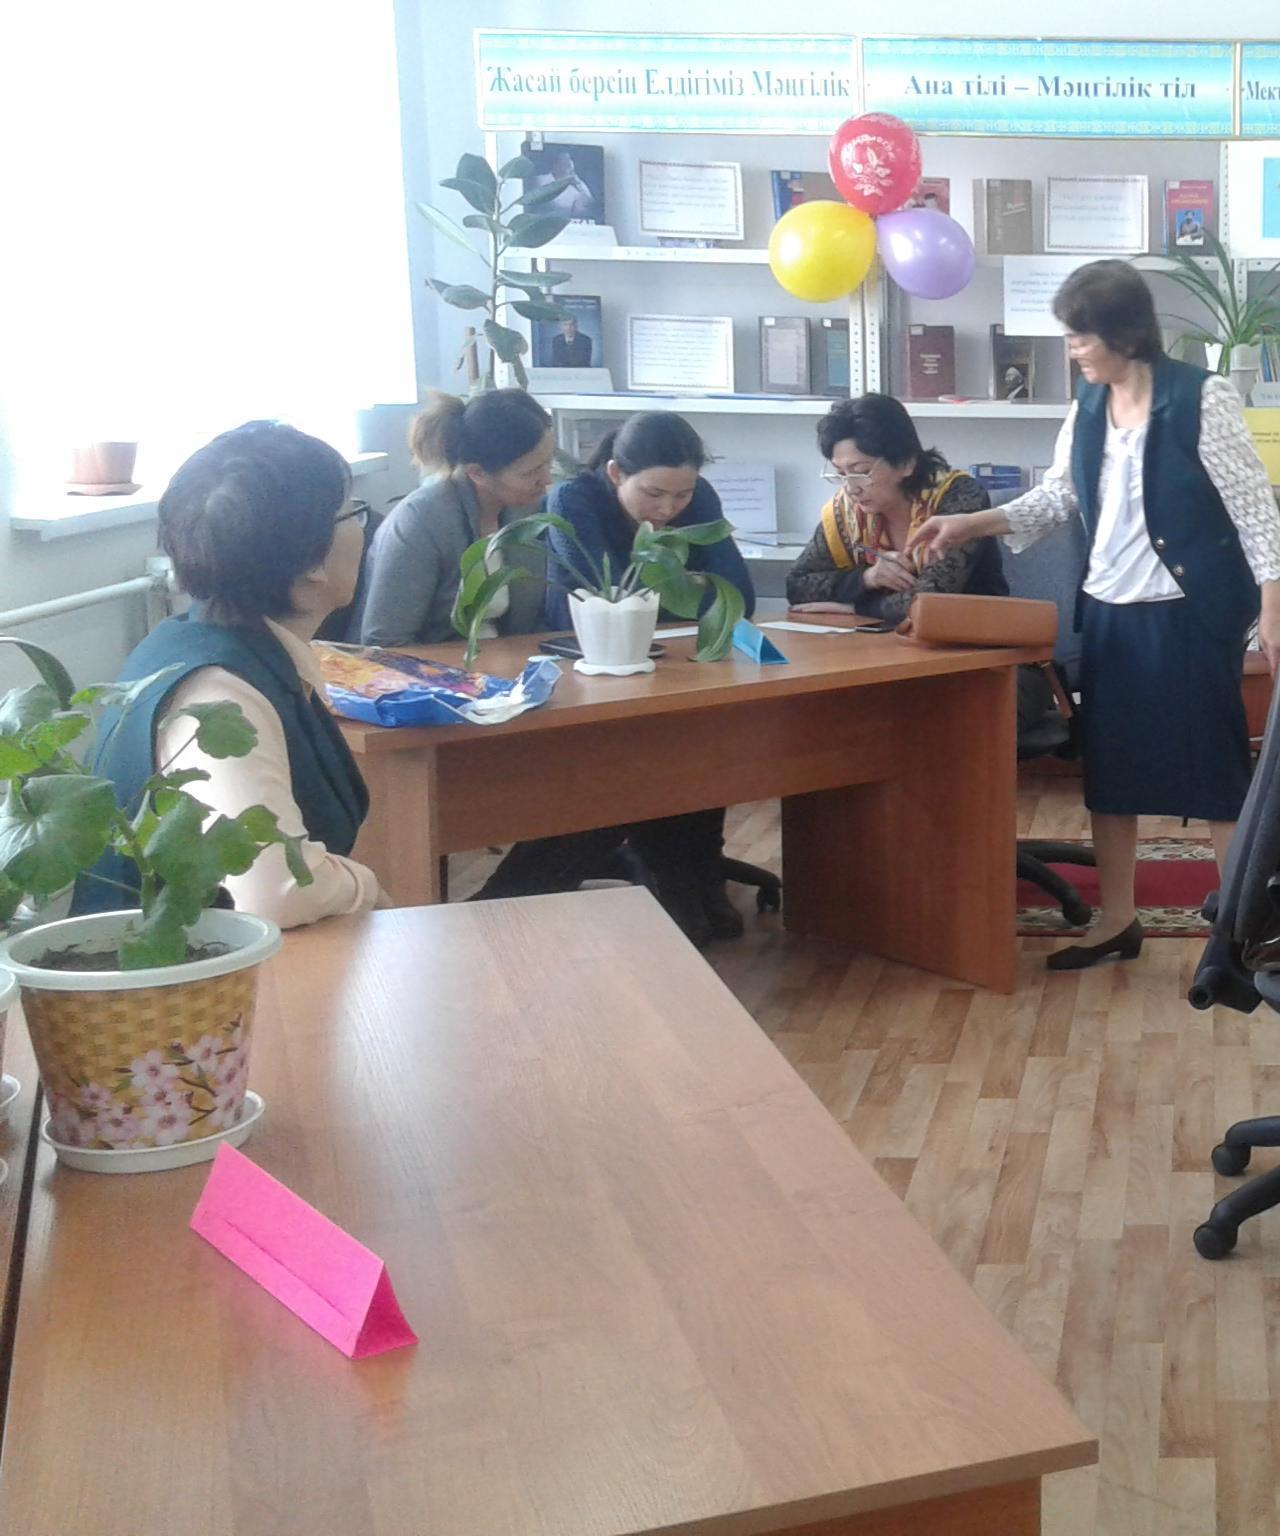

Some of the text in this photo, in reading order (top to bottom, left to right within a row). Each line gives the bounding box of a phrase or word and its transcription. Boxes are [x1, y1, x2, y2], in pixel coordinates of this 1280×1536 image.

[487, 66, 561, 93] Жасай
[569, 68, 637, 101] берсін
[904, 75, 954, 95] Ана
[961, 74, 1006, 96] тілі
[1160, 76, 1196, 98] тіл
